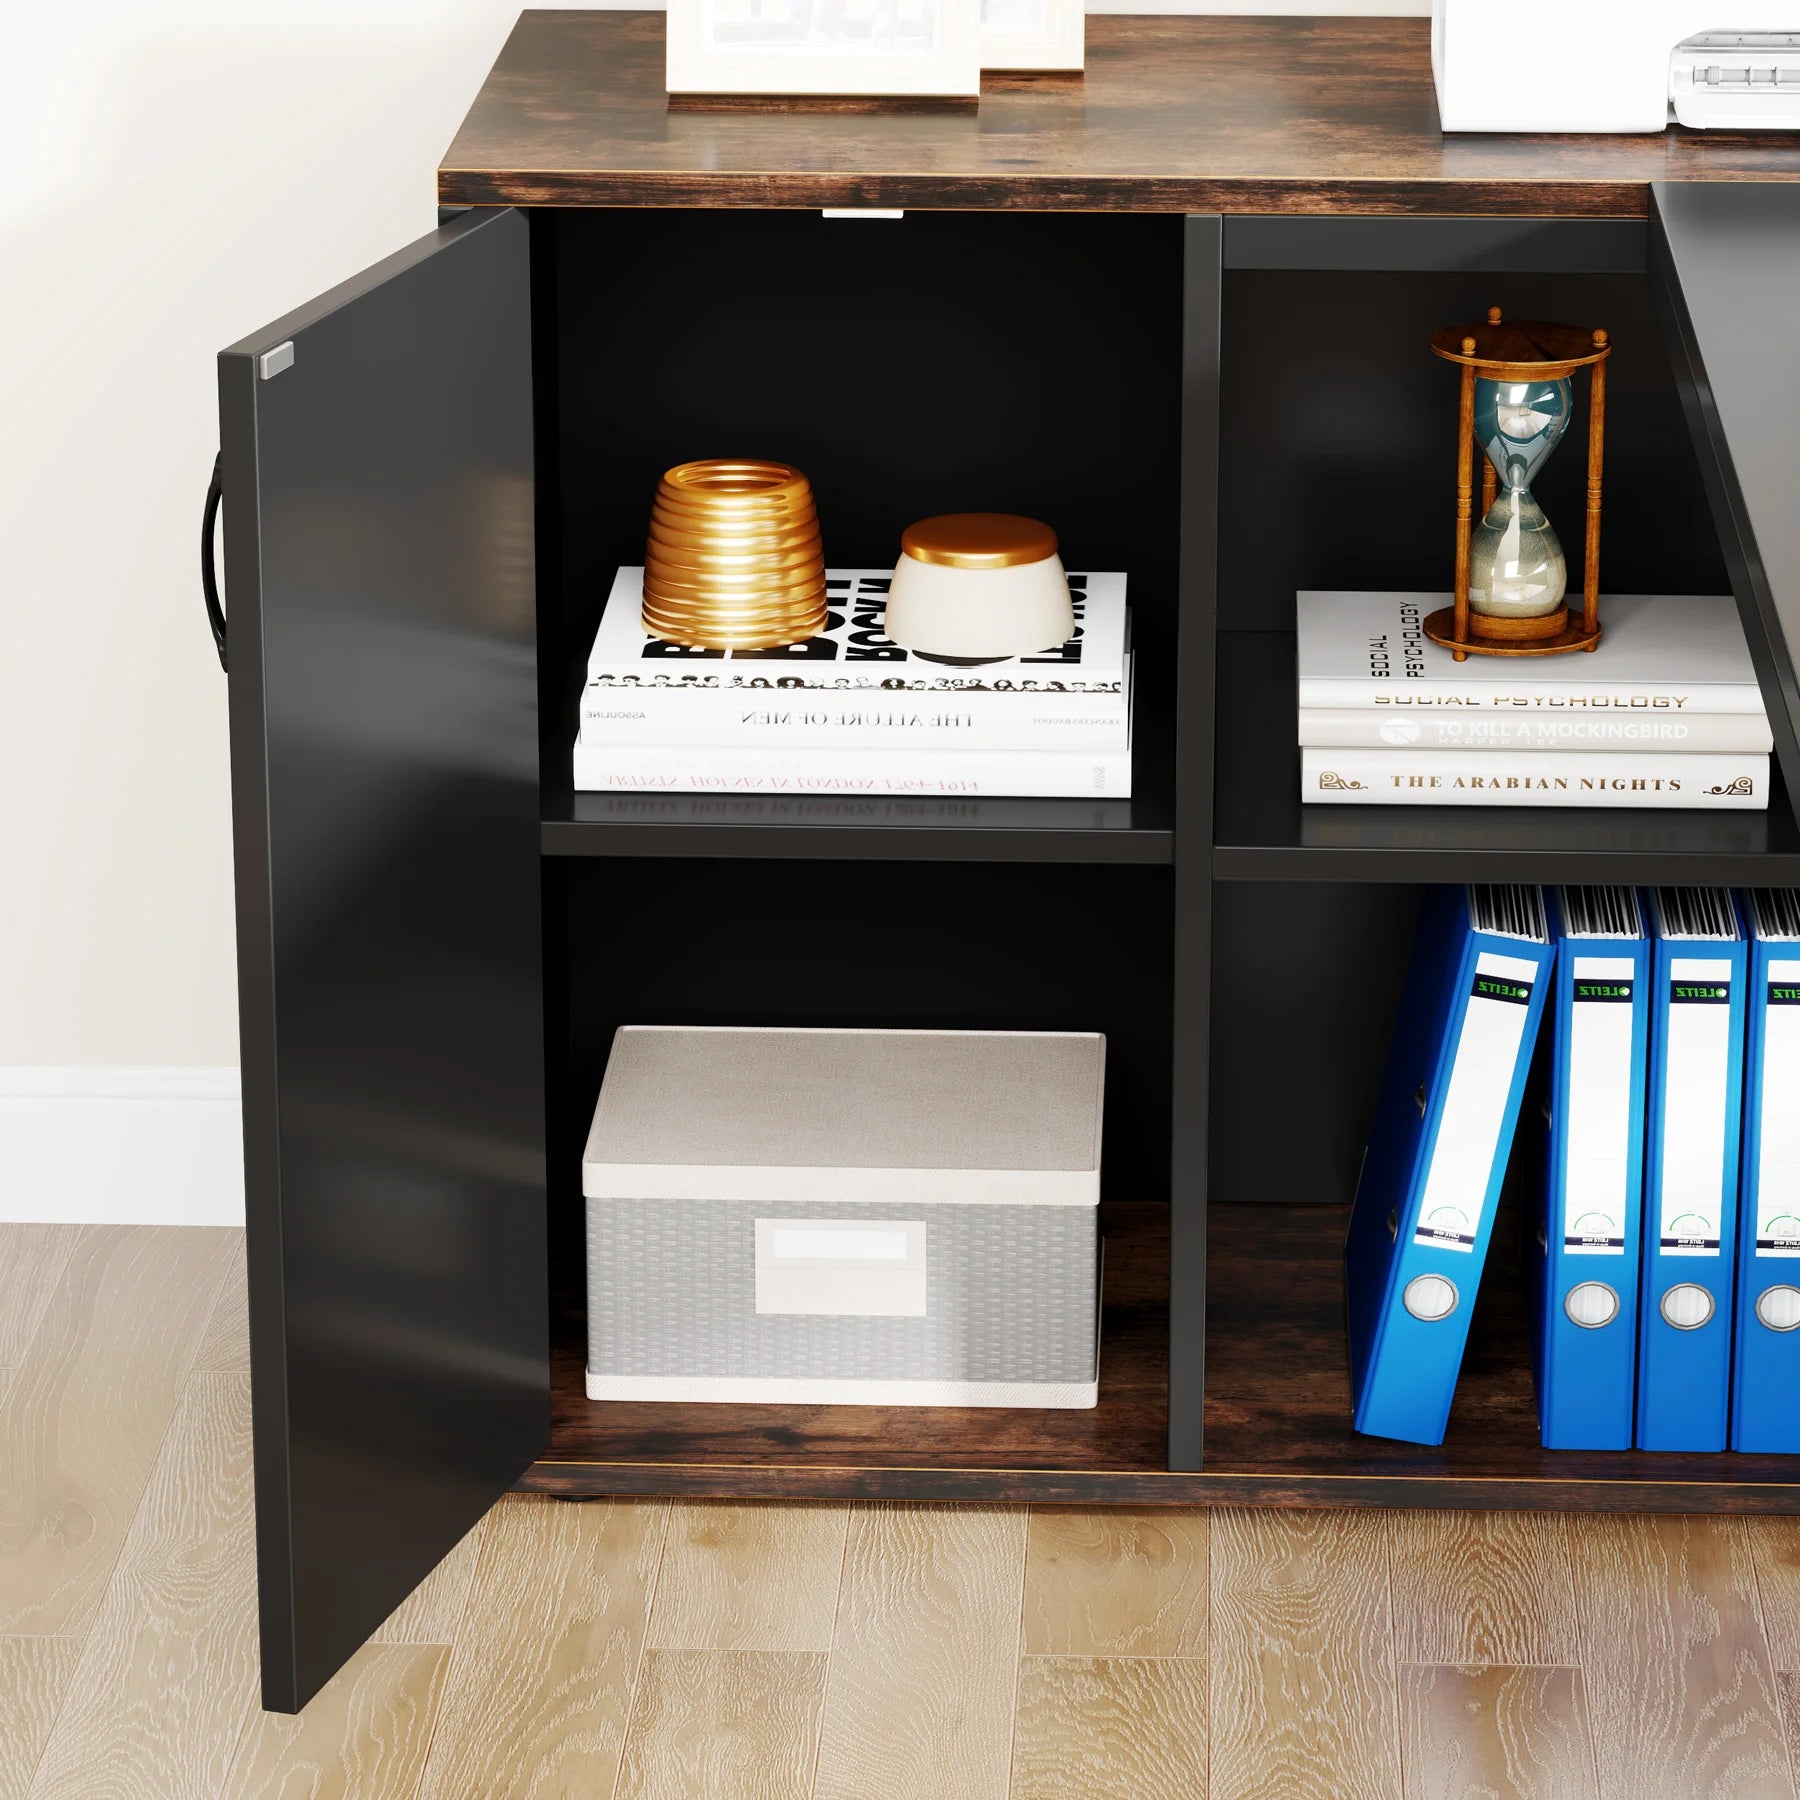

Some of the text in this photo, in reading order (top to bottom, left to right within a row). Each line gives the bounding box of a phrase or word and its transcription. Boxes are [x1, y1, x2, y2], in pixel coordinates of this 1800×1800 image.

[1400, 601, 1425, 678] PSYCHOLOGY
[1369, 634, 1390, 678] SOCIAL
[1374, 695, 1689, 708] SOCIAL PSYCHOLOGY
[1436, 720, 1689, 739] TO KILL A MOCKINGBIRD
[1438, 737, 1557, 746] HARPER LEE
[1391, 775, 1681, 791] THE ARABIAN NIGHTS
